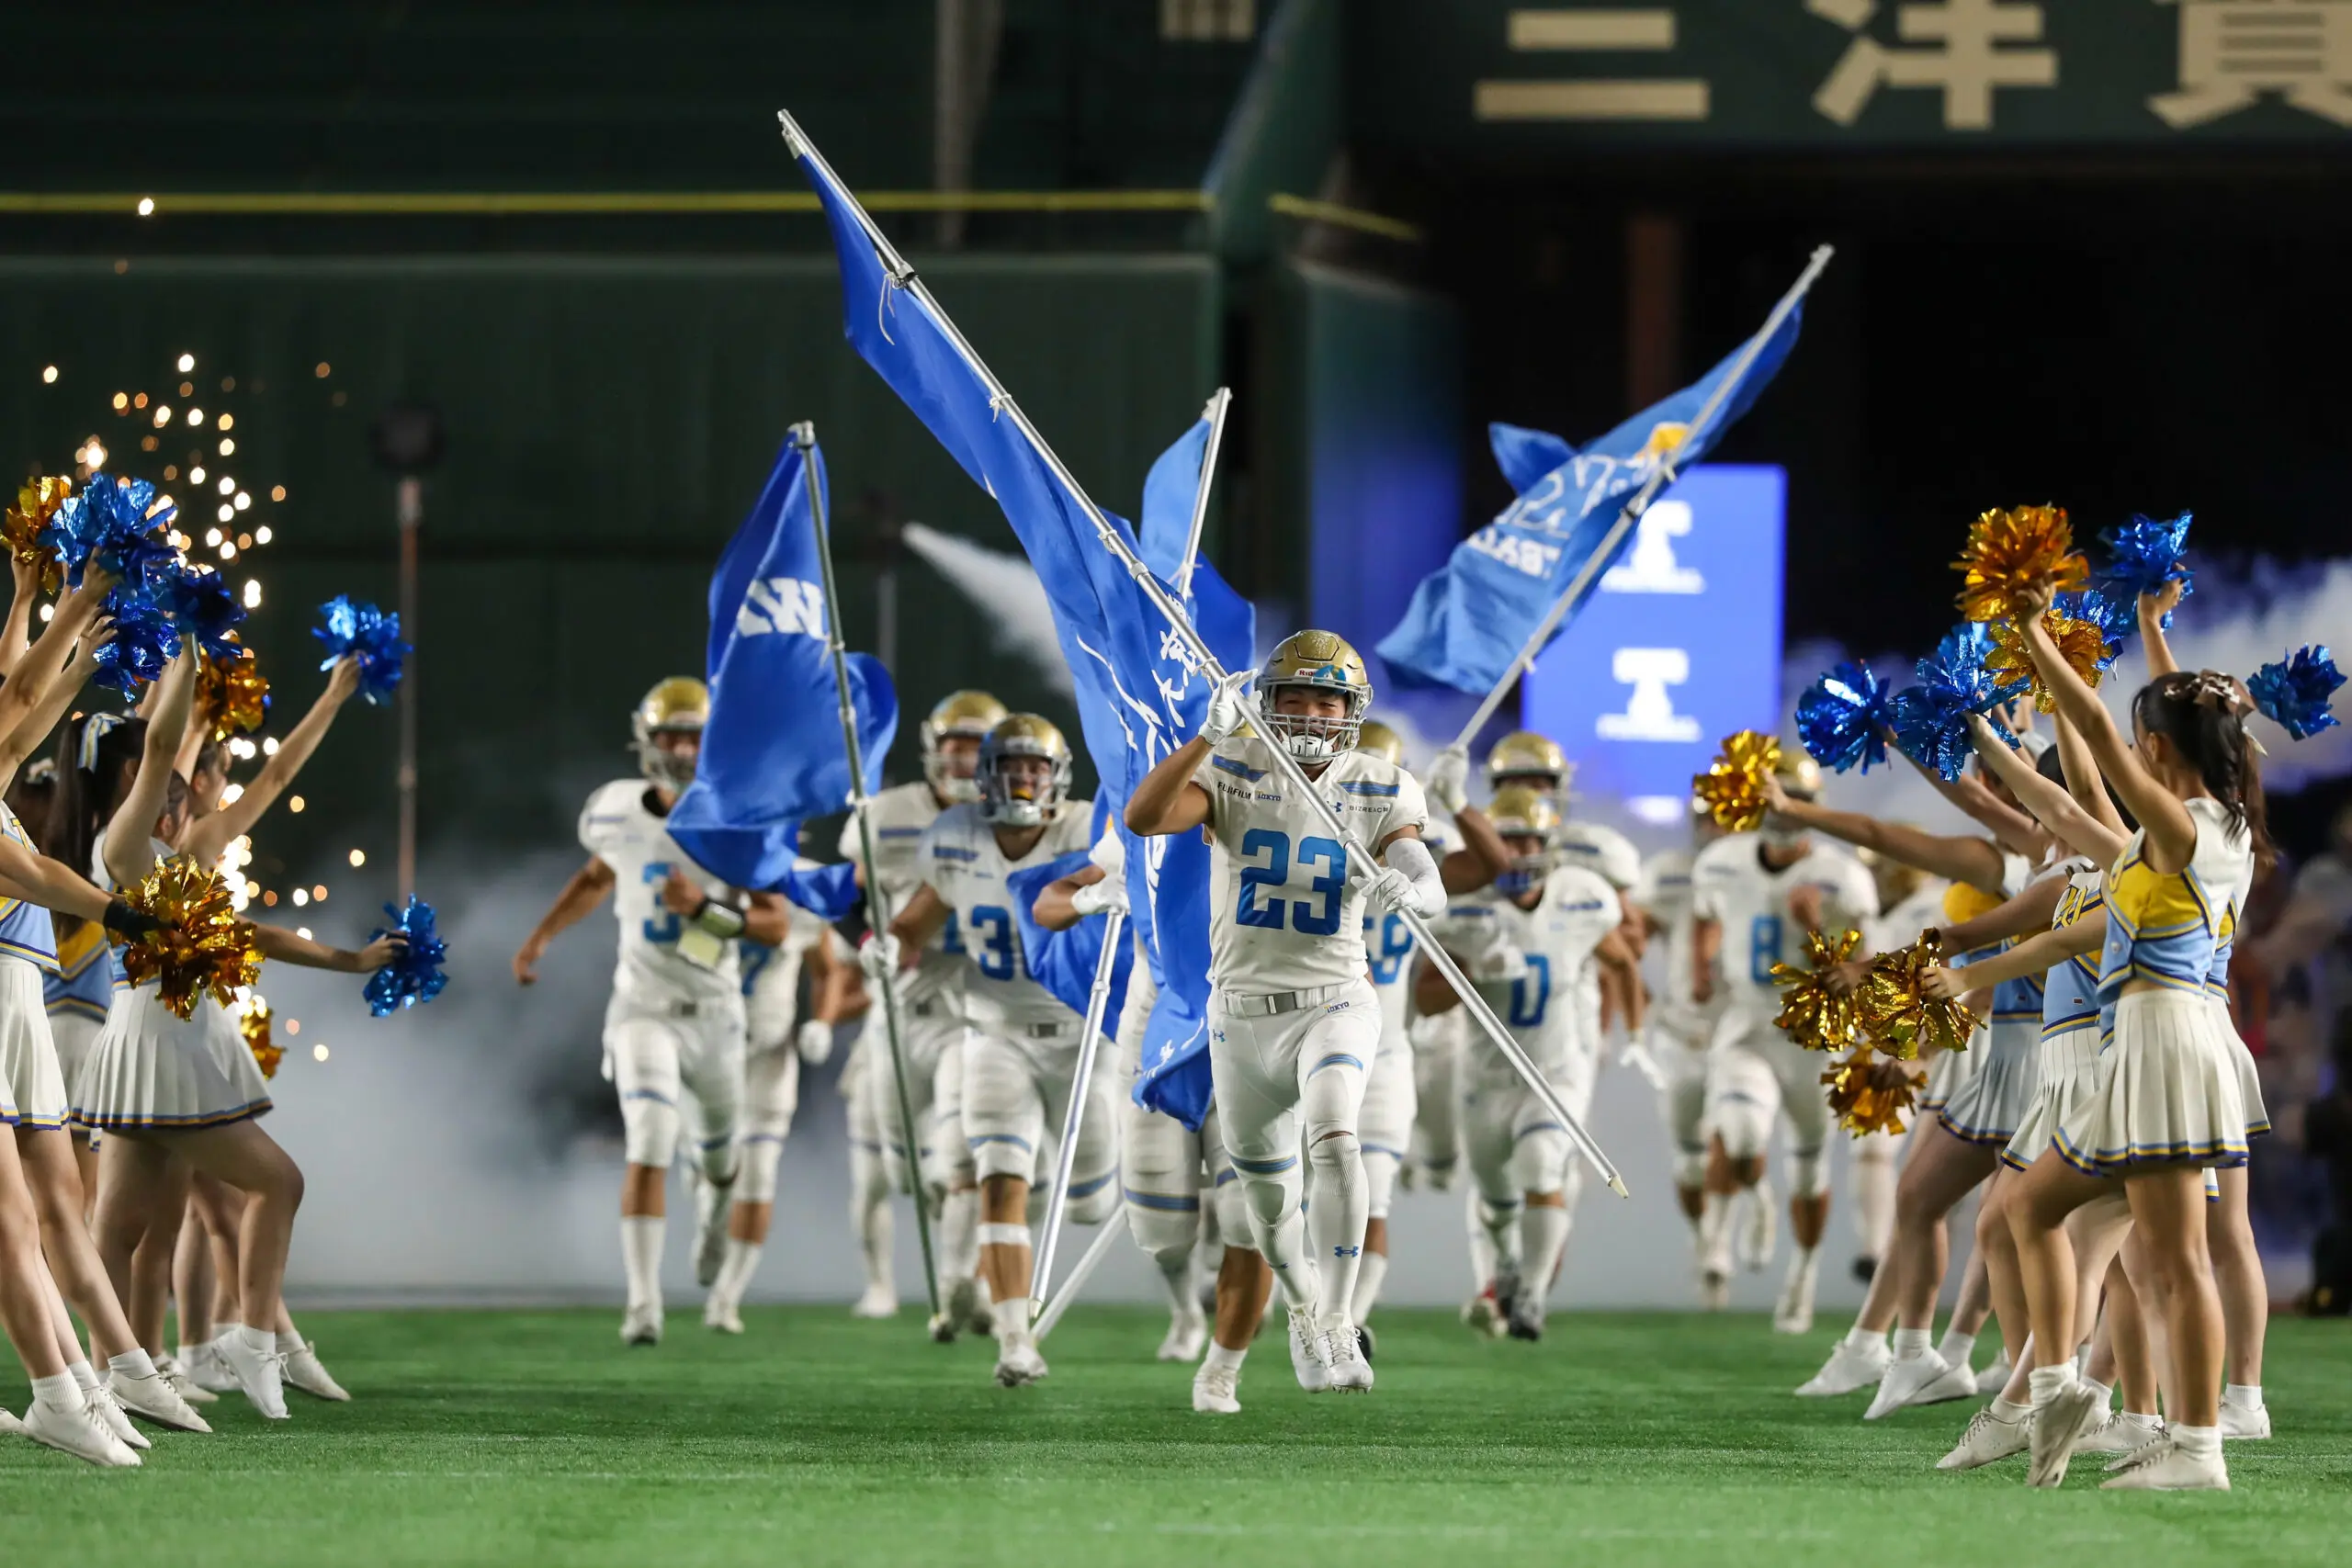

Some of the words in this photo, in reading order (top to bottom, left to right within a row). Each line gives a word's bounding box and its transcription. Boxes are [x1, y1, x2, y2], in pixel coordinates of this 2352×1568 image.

[1217, 781, 1251, 800] FUJIFILM
[1349, 805, 1389, 813] BIZREACH
[1237, 829, 1346, 936] 23
[1324, 1001, 1350, 1013] TOKYO
